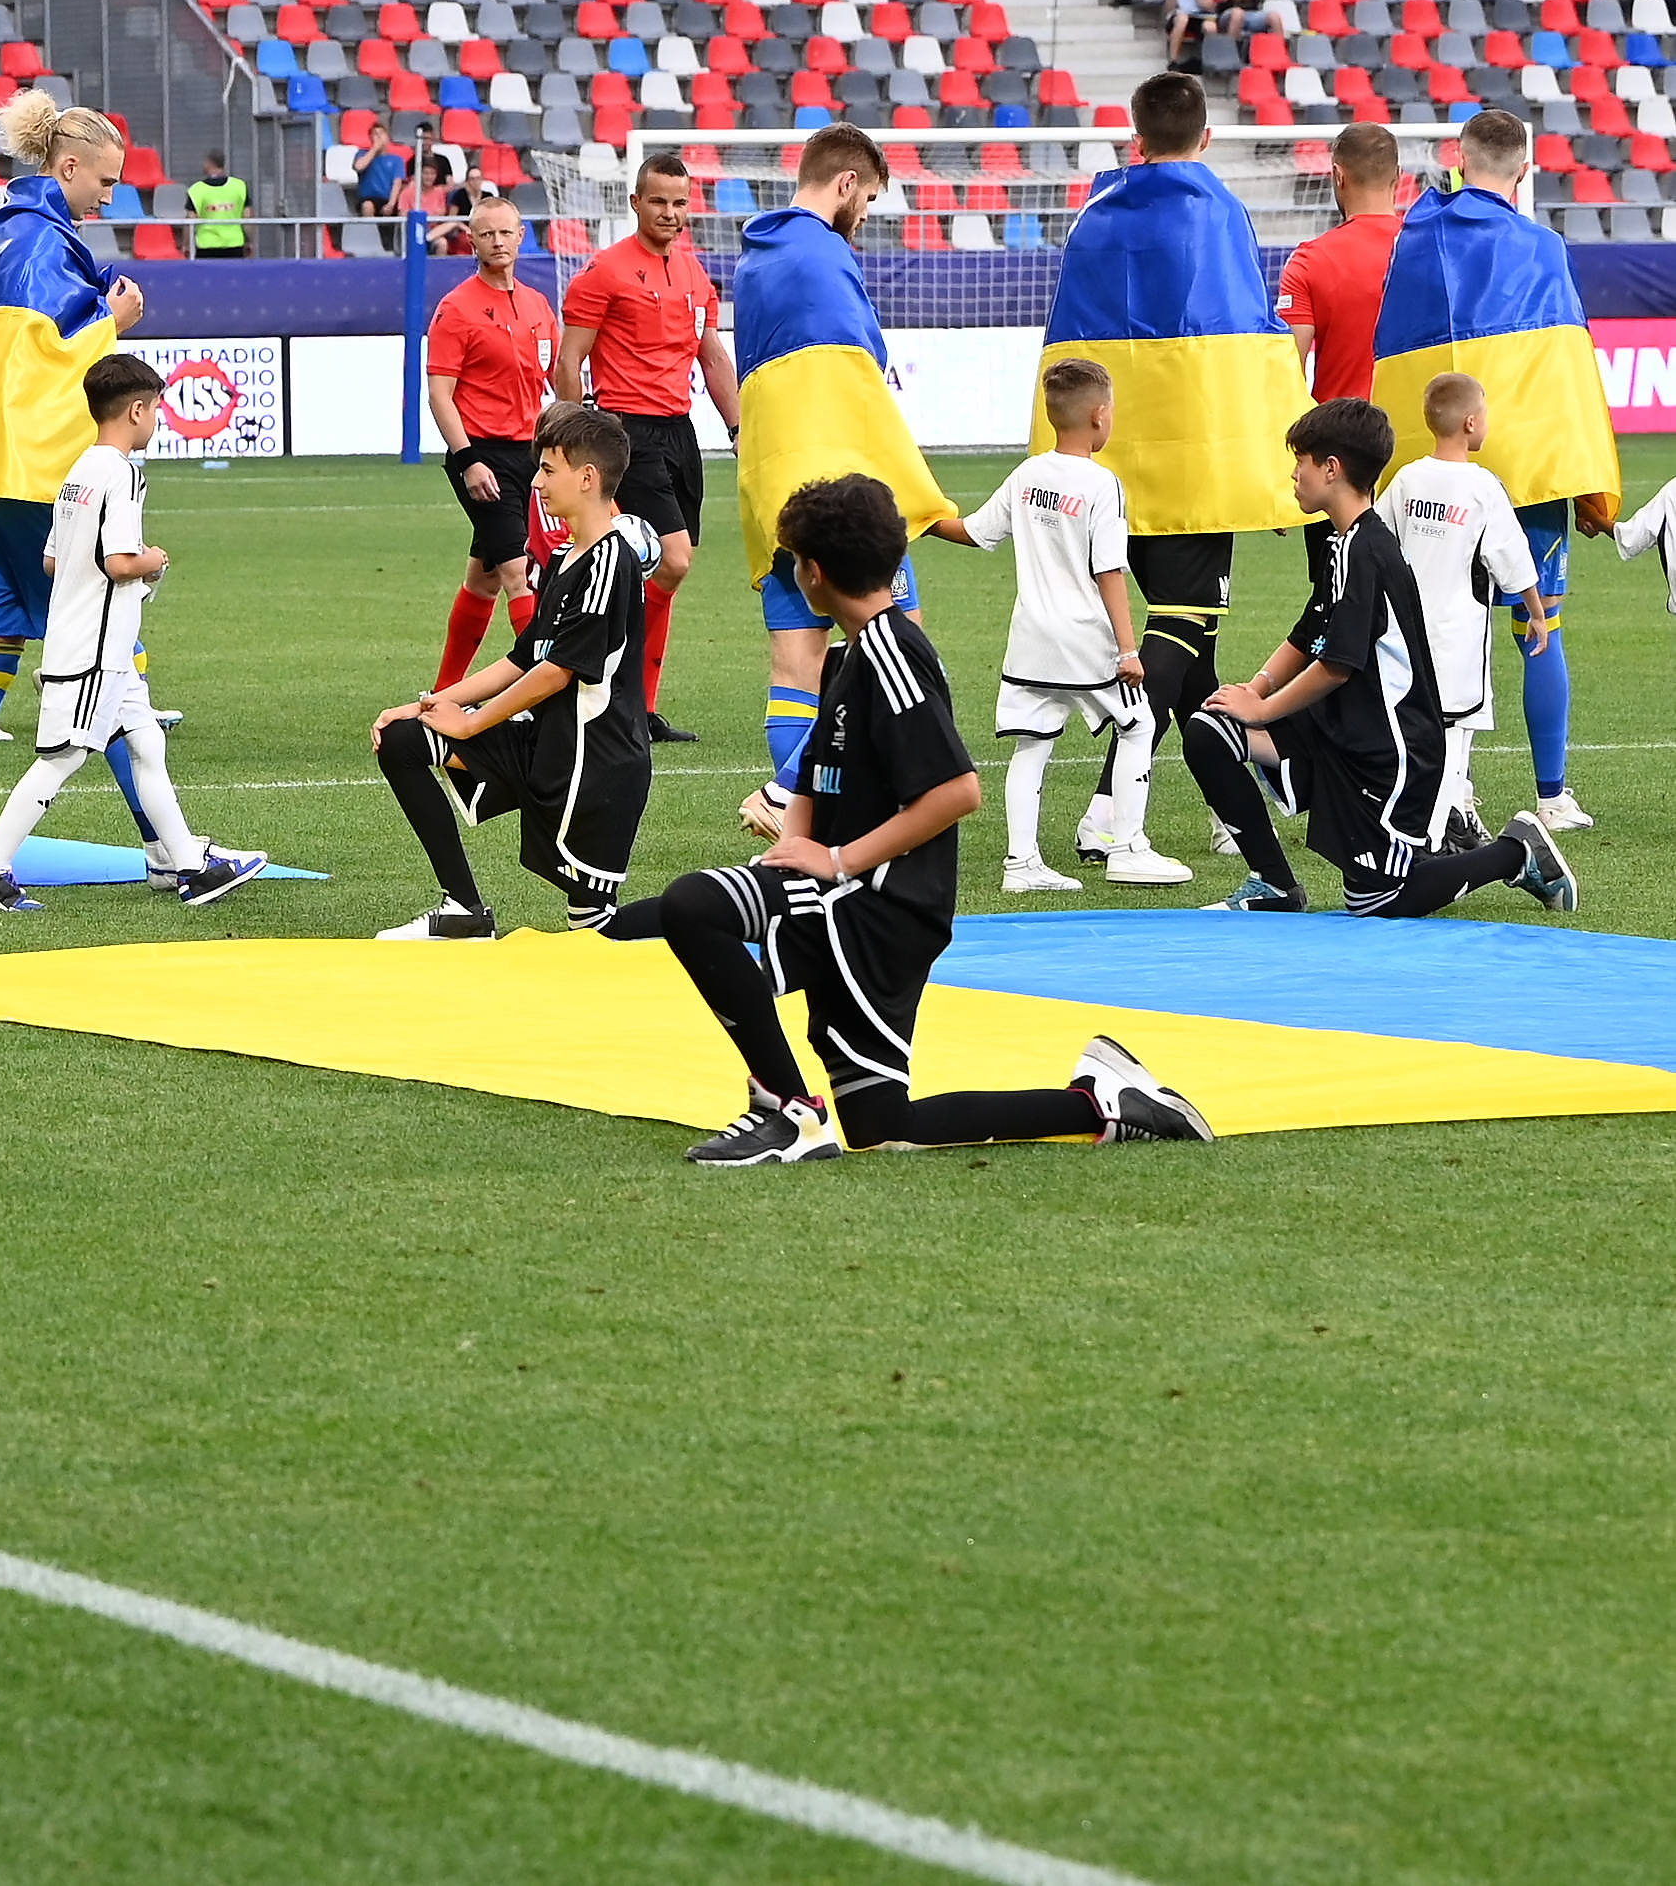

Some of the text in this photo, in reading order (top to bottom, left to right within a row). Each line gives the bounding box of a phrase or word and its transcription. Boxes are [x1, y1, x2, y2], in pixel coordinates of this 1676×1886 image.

[156, 349, 192, 365] HIT
[200, 347, 275, 365] RADIO
[163, 376, 233, 421] KISS
[203, 436, 276, 455] RADIO
[1022, 487, 1081, 518] #FOOTBALL
[1404, 498, 1468, 526] #FOOTBALL
